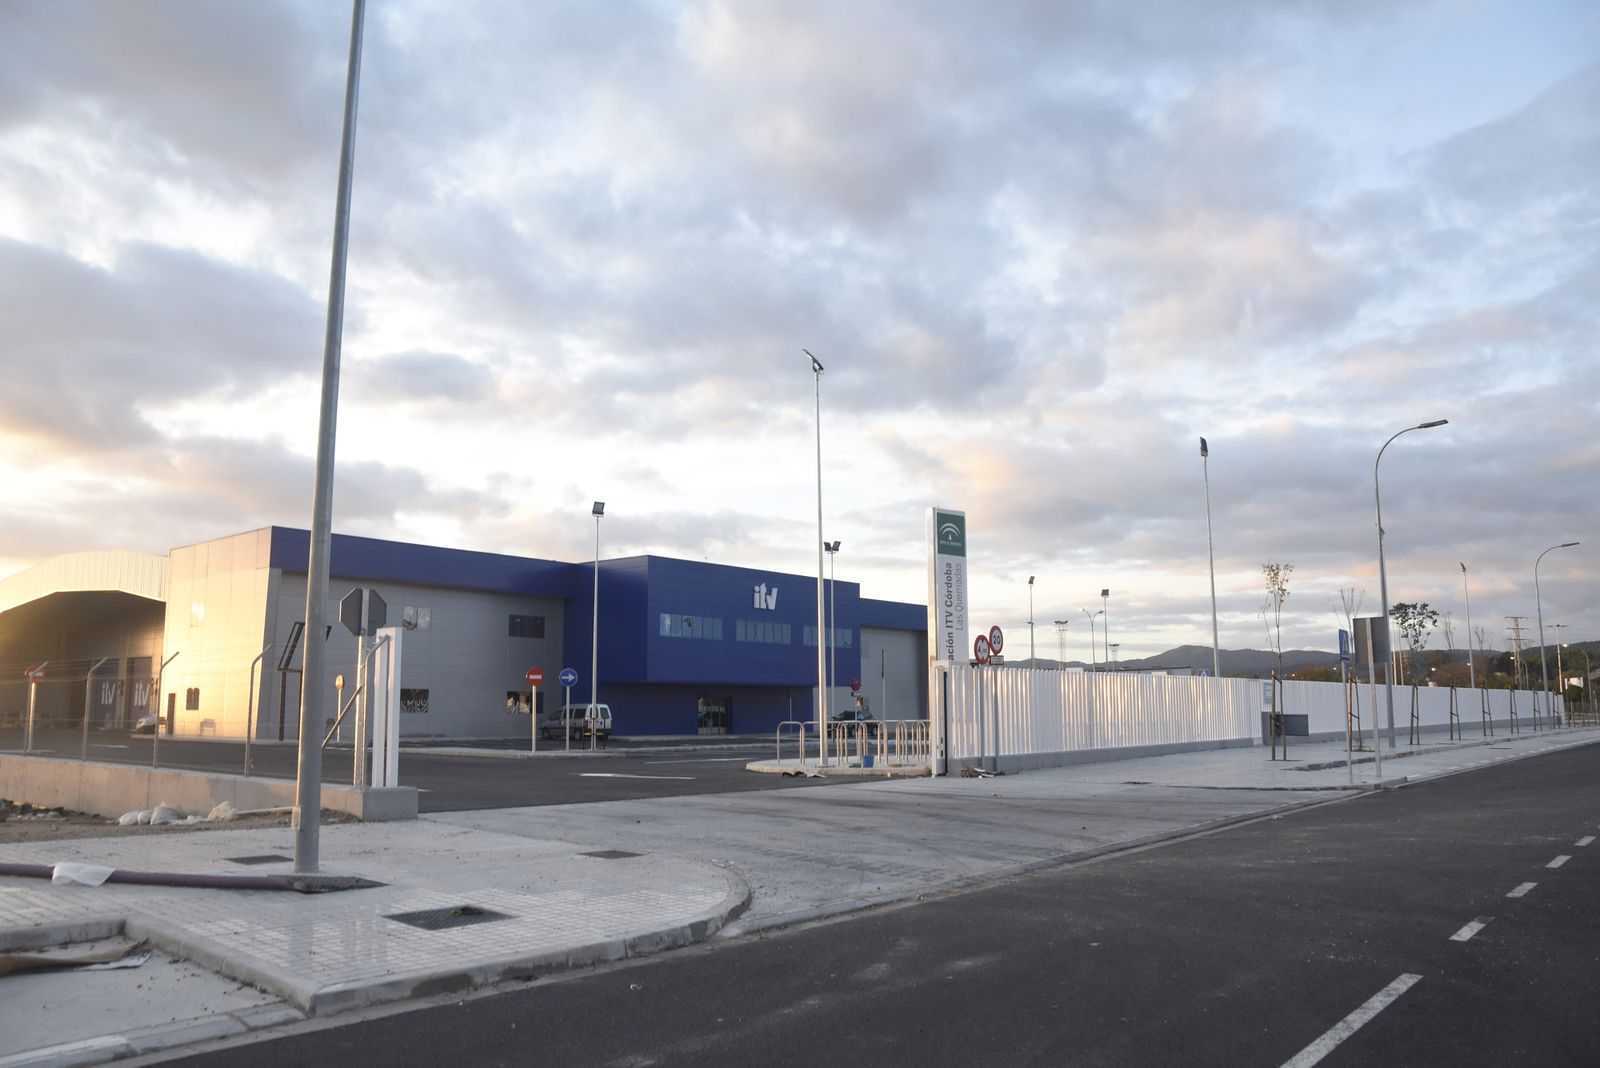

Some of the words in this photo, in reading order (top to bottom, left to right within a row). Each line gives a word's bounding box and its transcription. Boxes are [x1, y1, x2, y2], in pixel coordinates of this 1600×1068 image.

[753, 582, 778, 610] itv
[944, 562, 953, 608] Córdoba
[954, 562, 964, 612] Quemadas
[945, 610, 953, 629] ITV
[955, 614, 964, 631] Las
[992, 634, 1001, 645] 20
[101, 680, 116, 705] itv
[134, 680, 151, 706] itv
